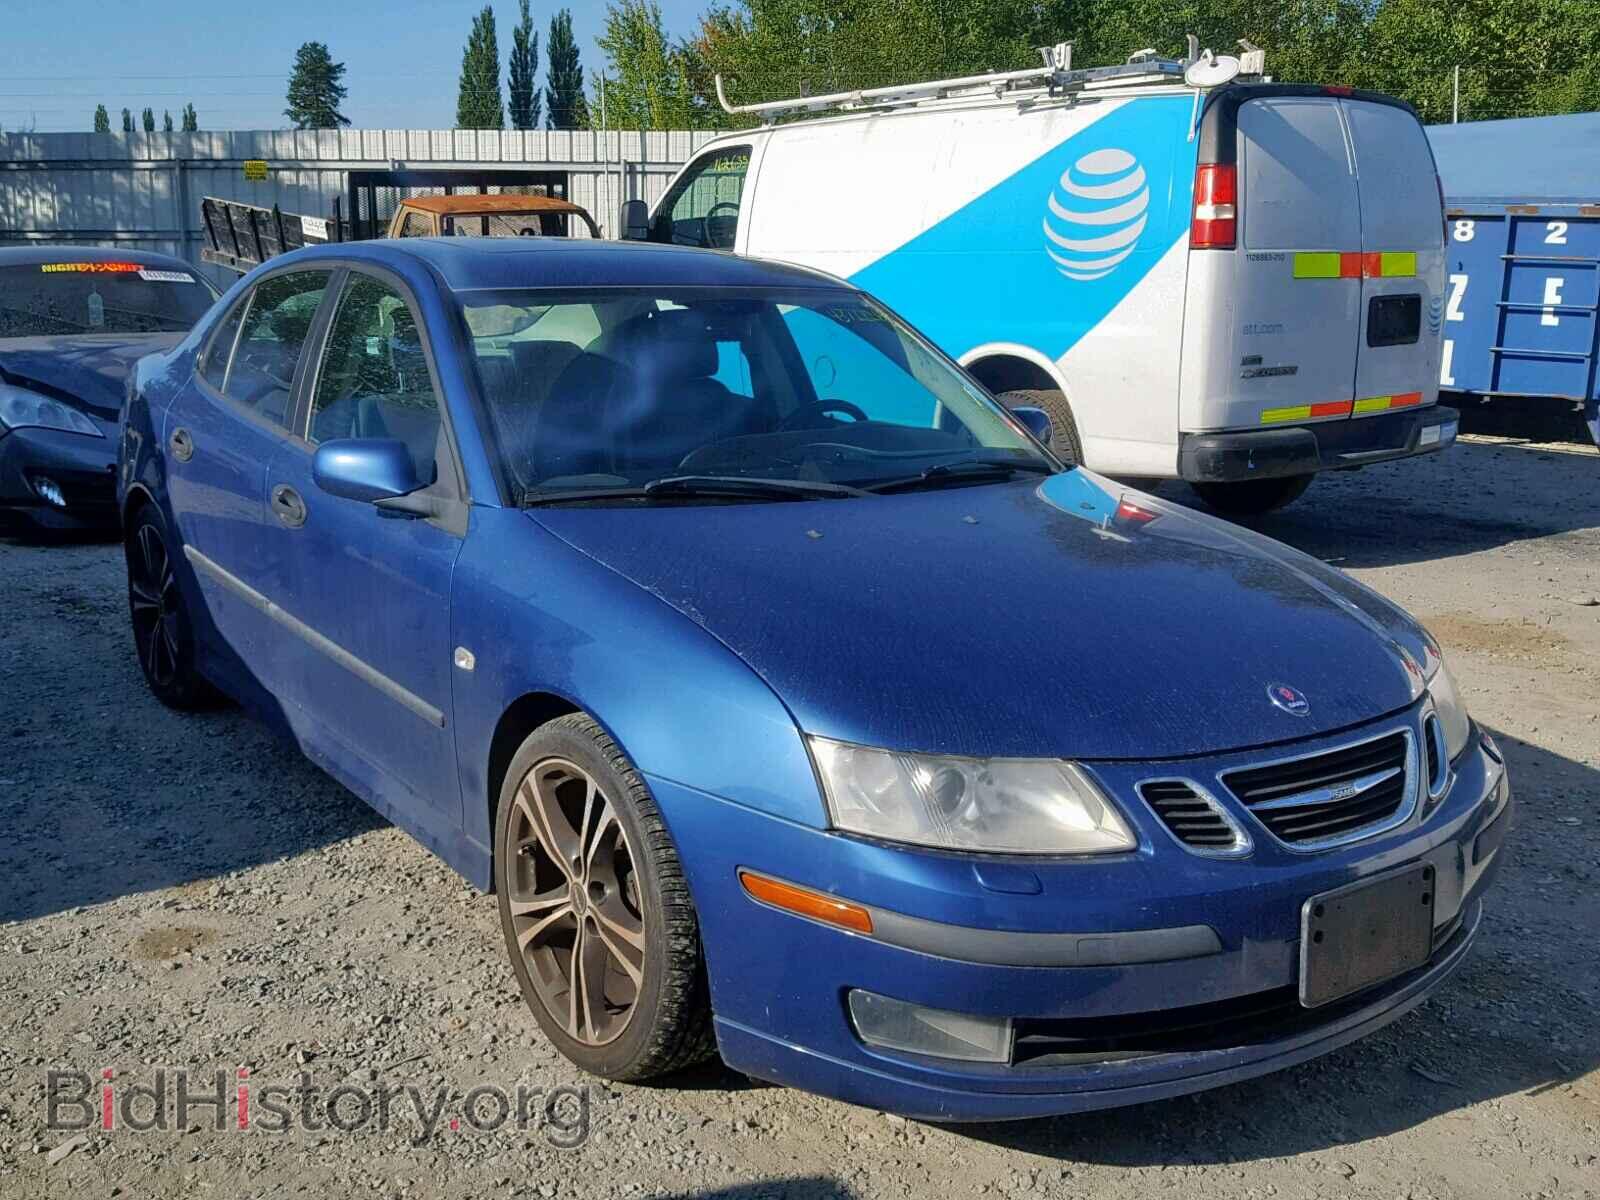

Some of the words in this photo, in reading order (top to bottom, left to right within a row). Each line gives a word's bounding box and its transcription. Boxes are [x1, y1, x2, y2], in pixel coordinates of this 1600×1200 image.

[1453, 220, 1475, 242] 8
[1544, 221, 1568, 244] 2
[1446, 274, 1469, 321] Z
[1540, 277, 1565, 326] E
